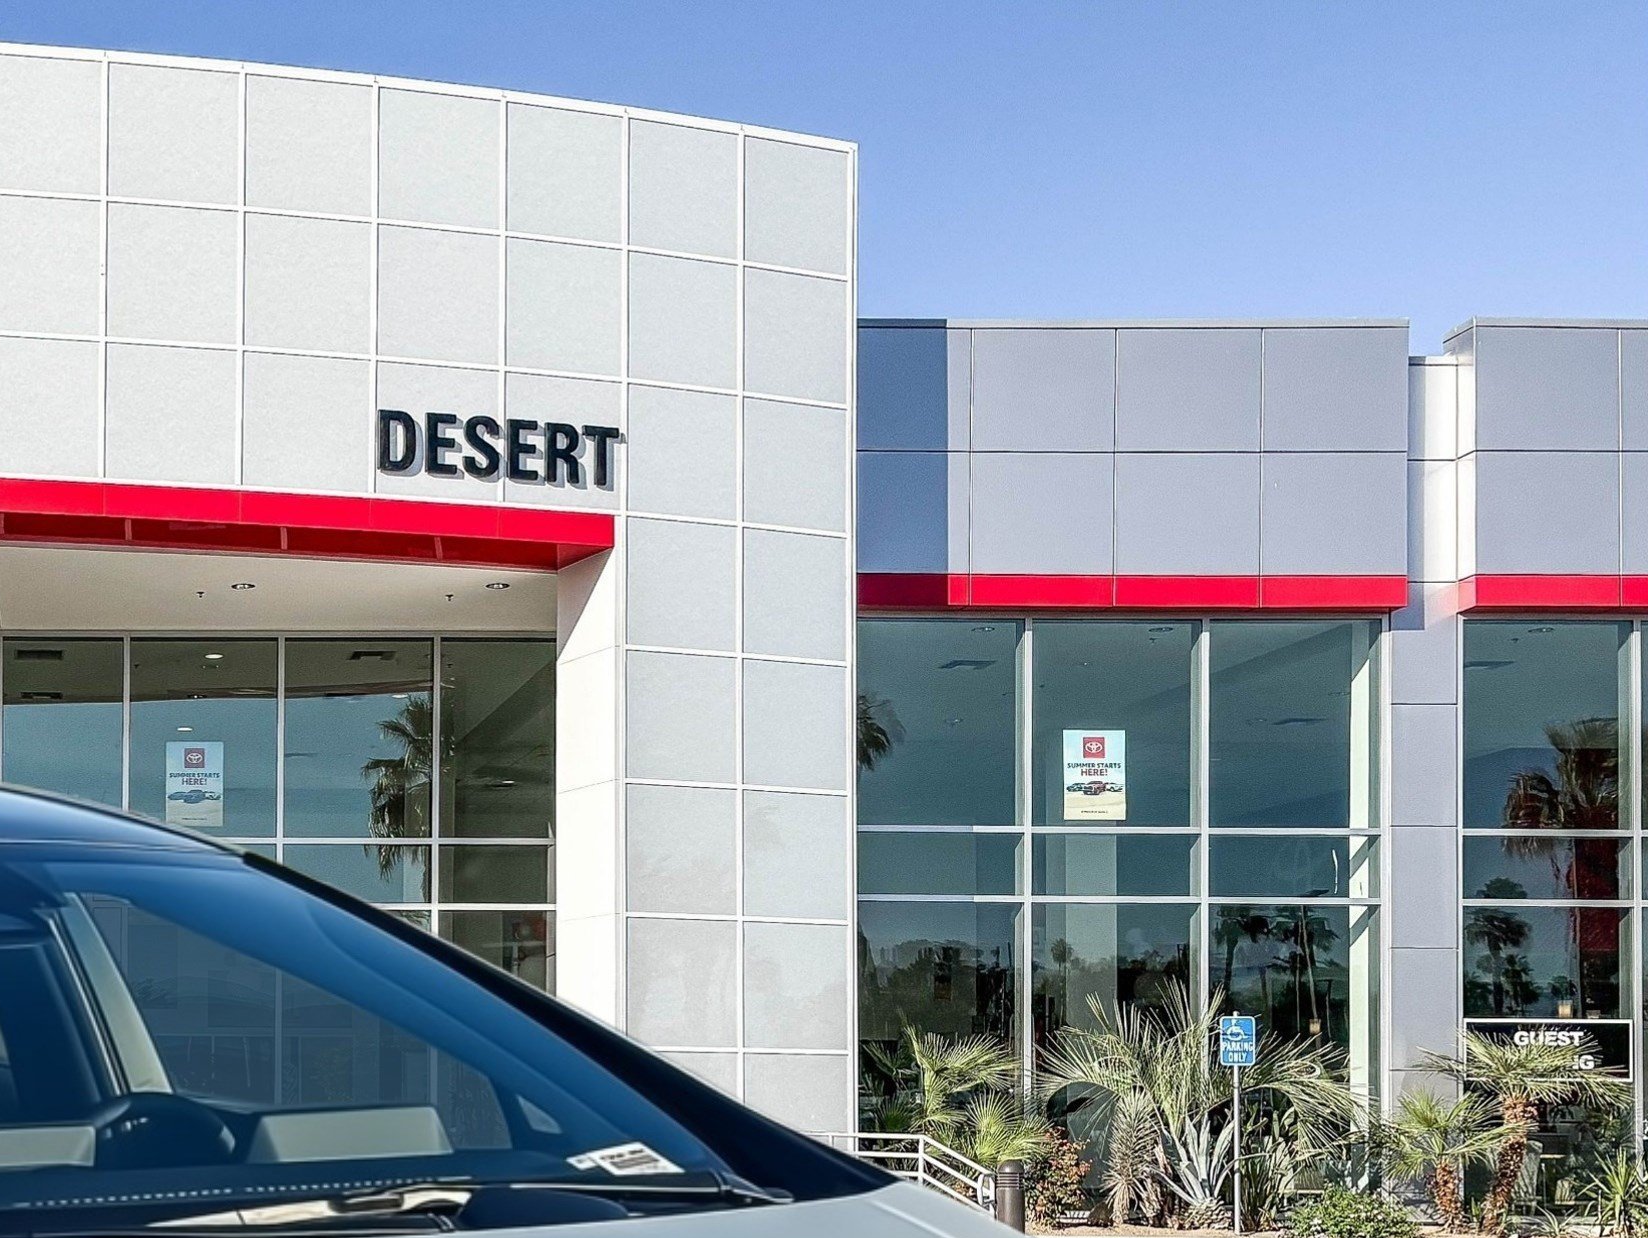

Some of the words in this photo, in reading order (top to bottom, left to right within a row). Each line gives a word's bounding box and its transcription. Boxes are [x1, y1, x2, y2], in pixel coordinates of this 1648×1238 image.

[377, 408, 620, 488] DESERT
[1513, 1030, 1584, 1046] GUEST
[1222, 1041, 1253, 1052] PARKING
[1228, 1052, 1247, 1063] ONLY
